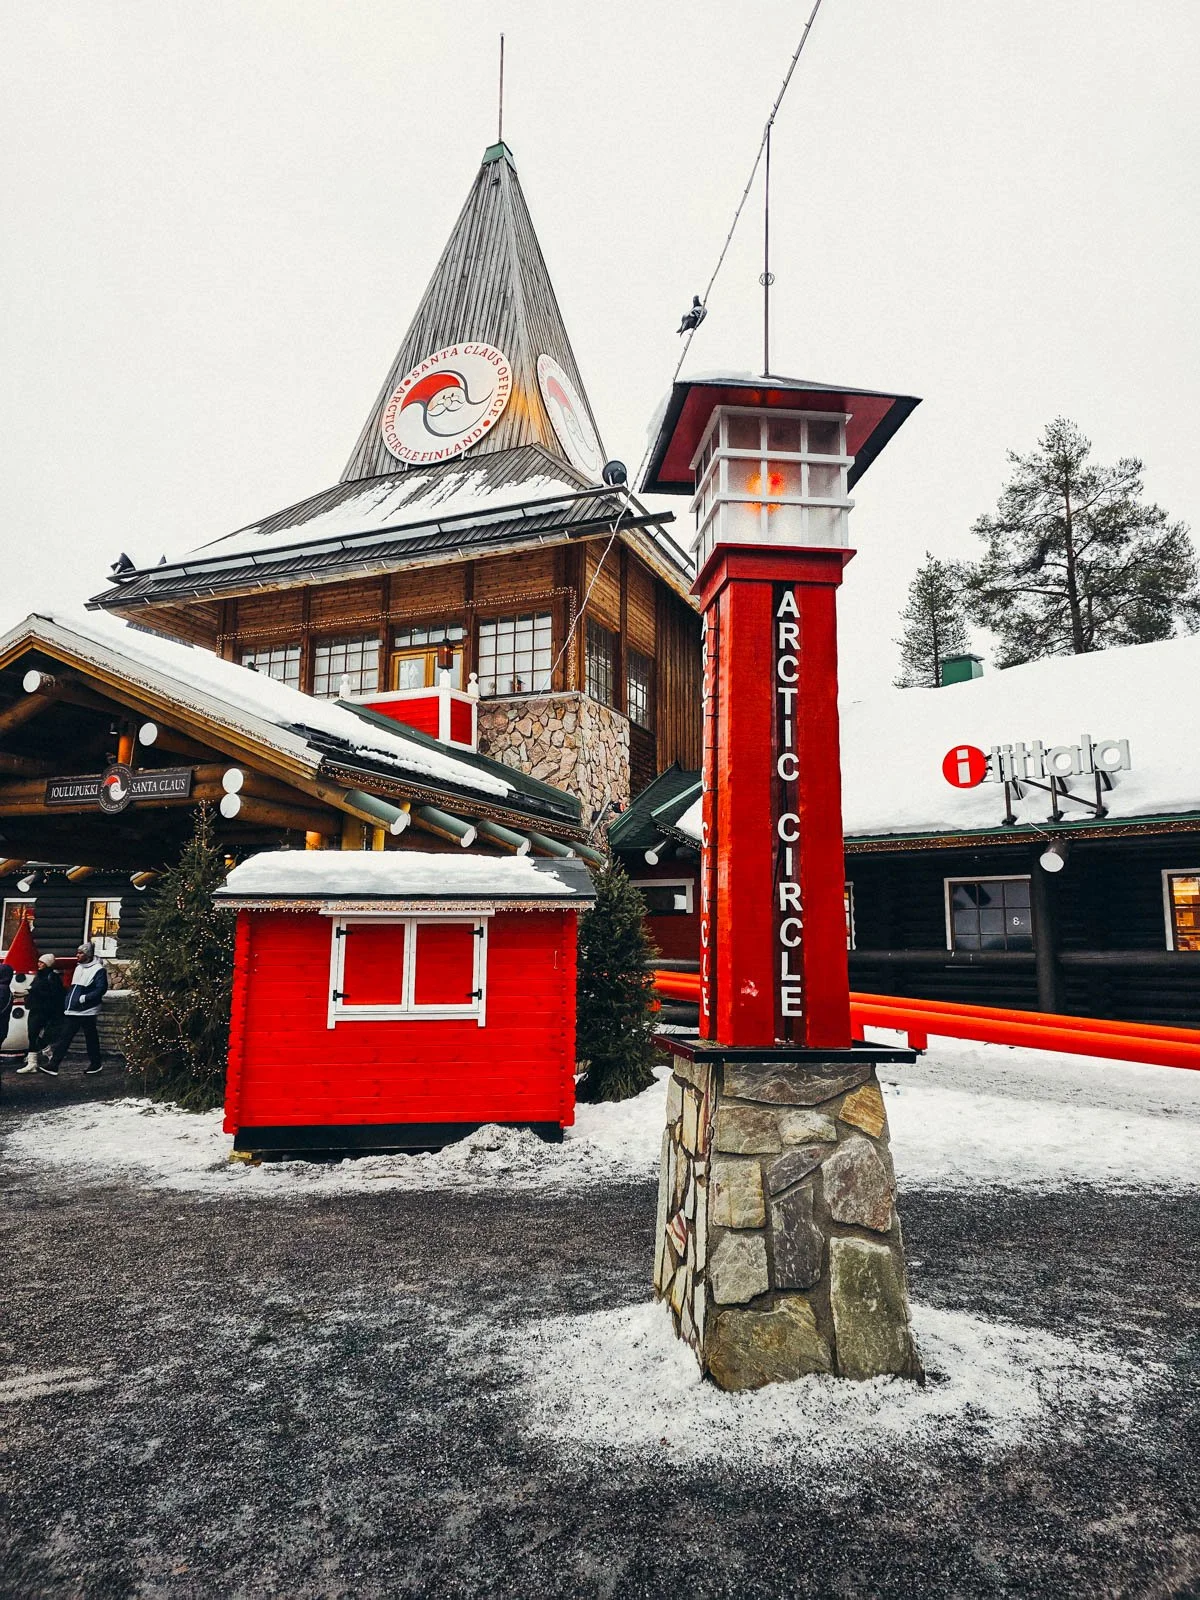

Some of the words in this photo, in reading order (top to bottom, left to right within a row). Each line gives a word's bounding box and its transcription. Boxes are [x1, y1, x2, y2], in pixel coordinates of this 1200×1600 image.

[411, 347, 459, 379] SANTA
[463, 345, 503, 366] CLAUS
[488, 366, 509, 418] OFFICE
[385, 386, 406, 433] ARCTIC
[386, 433, 420, 461] CIRCLE
[420, 428, 483, 462] FINLAND
[776, 590, 801, 782] ARCTIC
[990, 734, 1131, 784] iittala
[50, 784, 99, 799] JOULUPUKKI
[131, 781, 158, 793] SANTA
[159, 778, 185, 792] CLAUS
[777, 812, 803, 1017] CIRCLE
